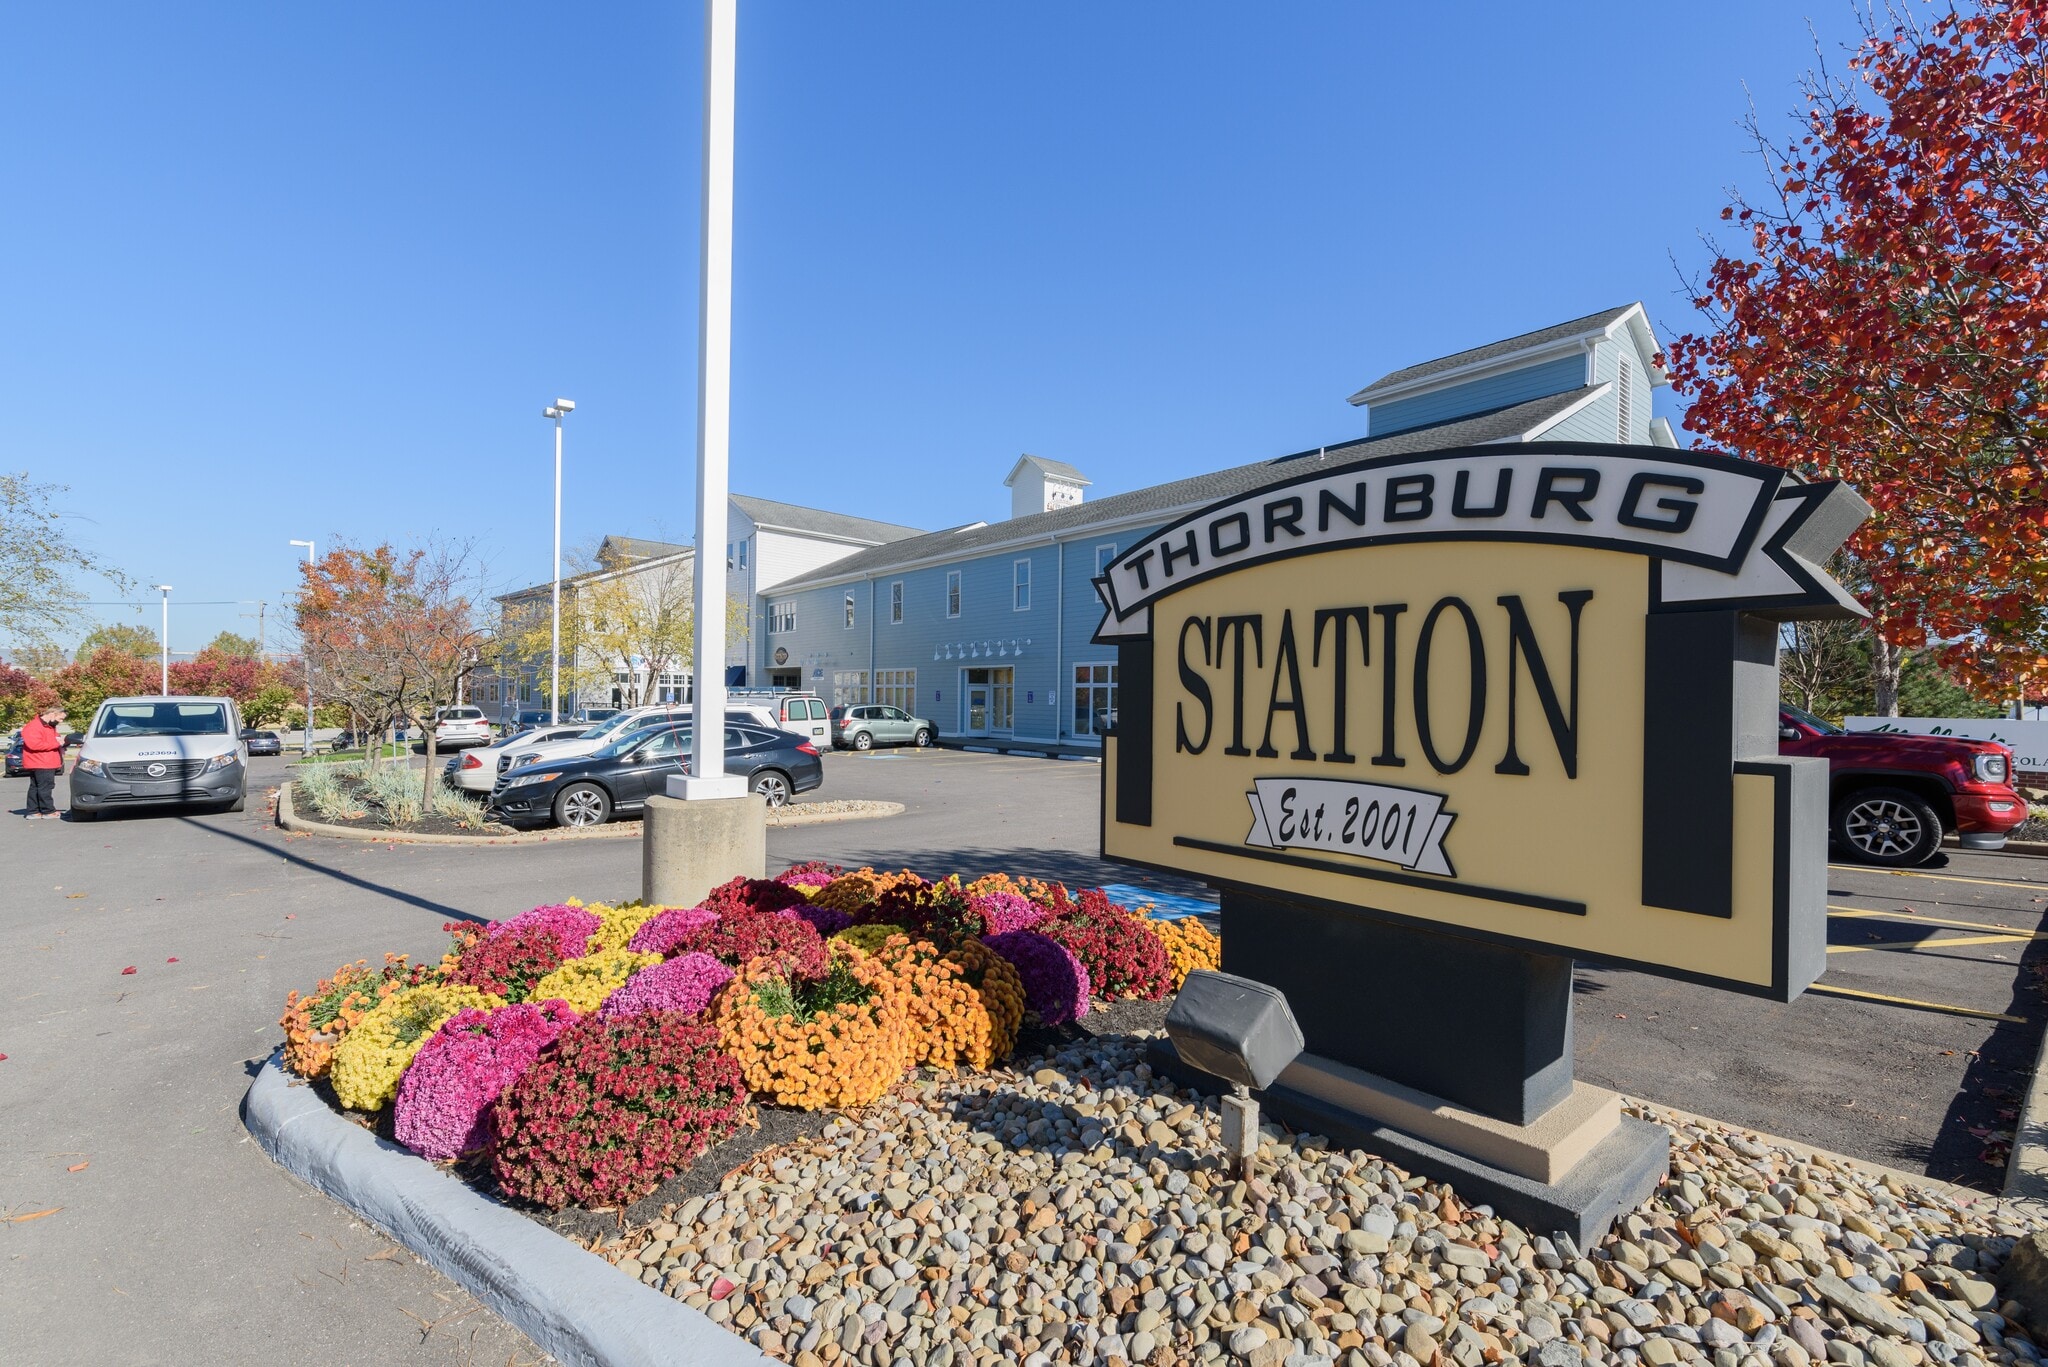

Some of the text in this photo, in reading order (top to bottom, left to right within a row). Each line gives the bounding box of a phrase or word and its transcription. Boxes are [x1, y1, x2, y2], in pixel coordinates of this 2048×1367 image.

[1123, 467, 1705, 590] THORNBURG
[1176, 589, 1594, 779] STATION
[1278, 787, 1417, 855] Est. 2001
